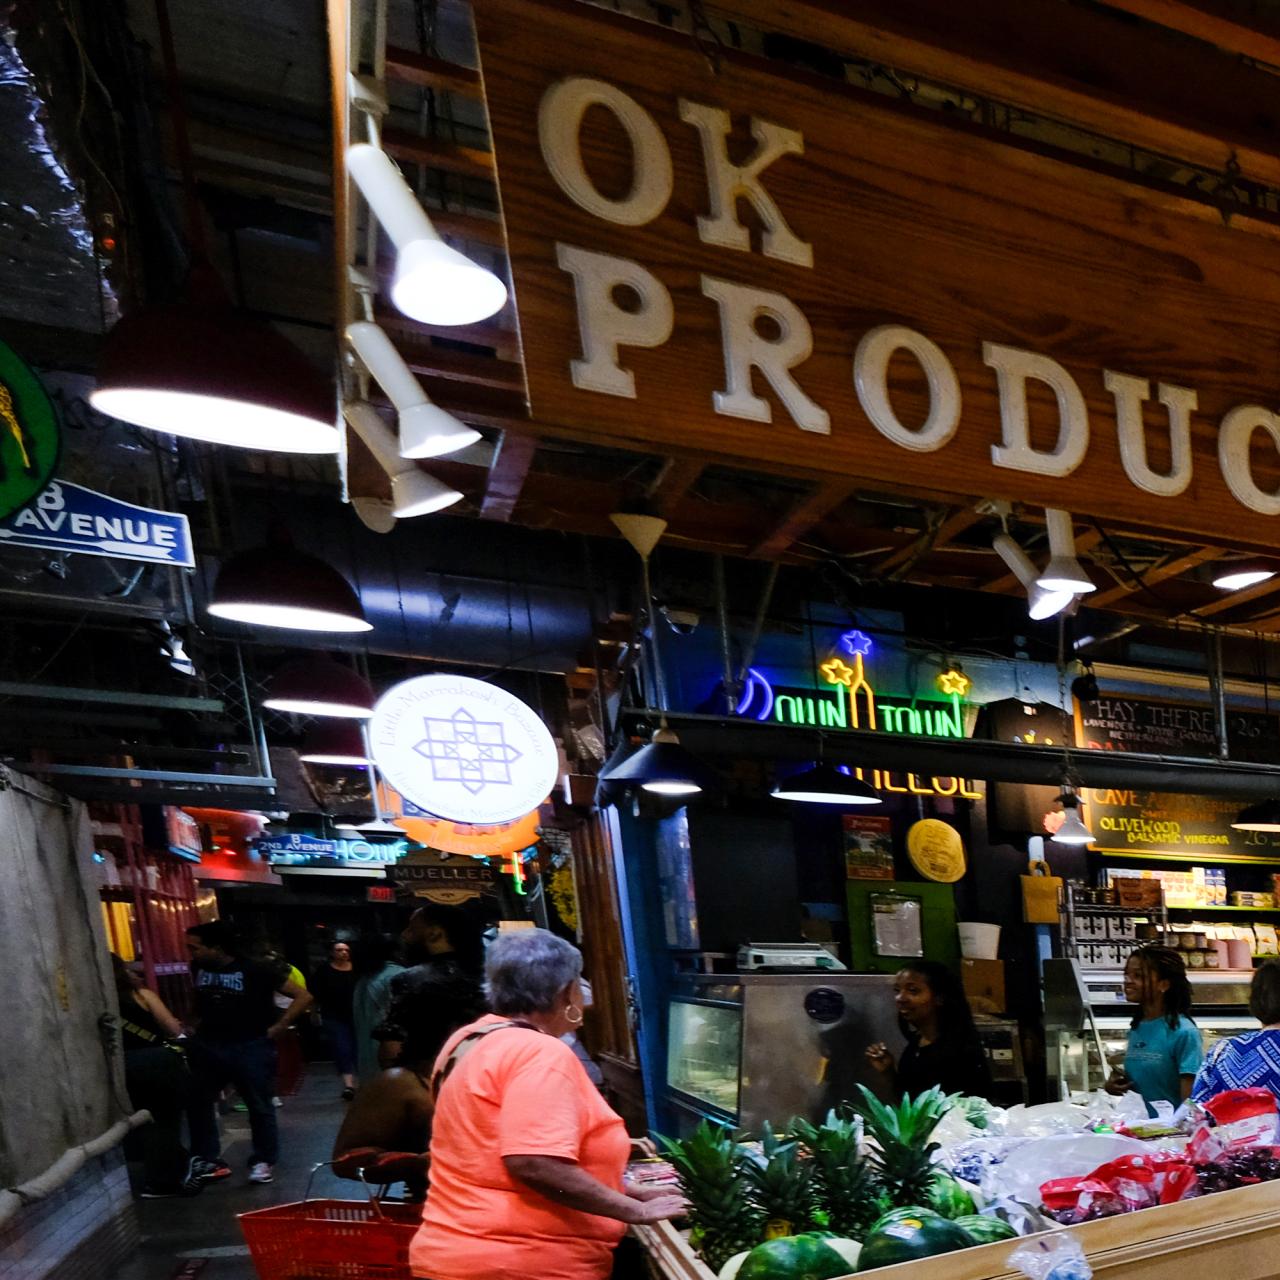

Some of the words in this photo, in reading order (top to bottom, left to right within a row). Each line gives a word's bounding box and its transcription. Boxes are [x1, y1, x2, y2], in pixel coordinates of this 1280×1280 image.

[537, 76, 814, 268] OK
[14, 507, 178, 547] AVENUE
[1148, 706, 1215, 734] THERE
[1100, 817, 1181, 833] OLIVEWOOD
[1127, 832, 1181, 844] BALSAMIC
[1184, 834, 1230, 845] VINEGAR
[286, 842, 334, 852] AVENUE
[393, 867, 493, 880] MUELLER
